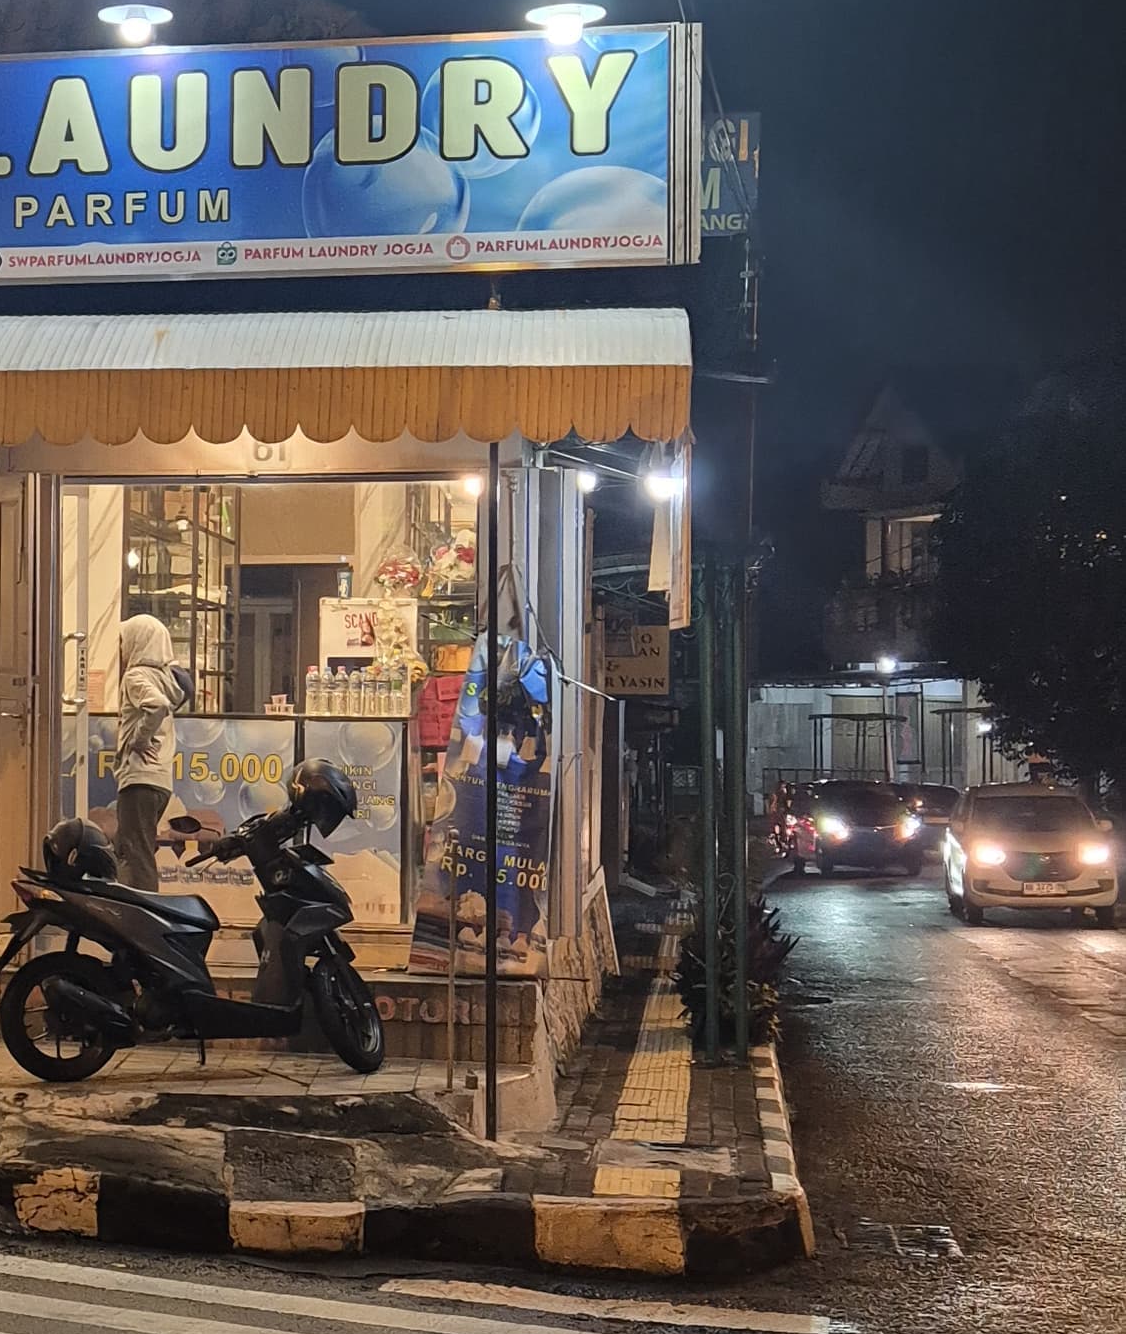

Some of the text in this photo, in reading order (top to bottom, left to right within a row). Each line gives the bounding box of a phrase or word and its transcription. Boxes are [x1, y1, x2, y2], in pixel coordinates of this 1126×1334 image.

[14, 188, 230, 228] PARFUM
[244, 241, 434, 260] PARFUM LAUNDRY JOGJA
[476, 234, 664, 254] PARFUMLAUNDRYJOGJA
[8, 250, 202, 268] SWPARFUMLAUNDRYJOGJA
[619, 675, 665, 688] YASIN
[174, 751, 283, 783] 15.000
[344, 766, 372, 776] IKIN
[353, 781, 377, 790] NGI
[444, 842, 487, 862] HARG
[496, 868, 548, 891] 5.000
[375, 995, 470, 1025] OTOR
